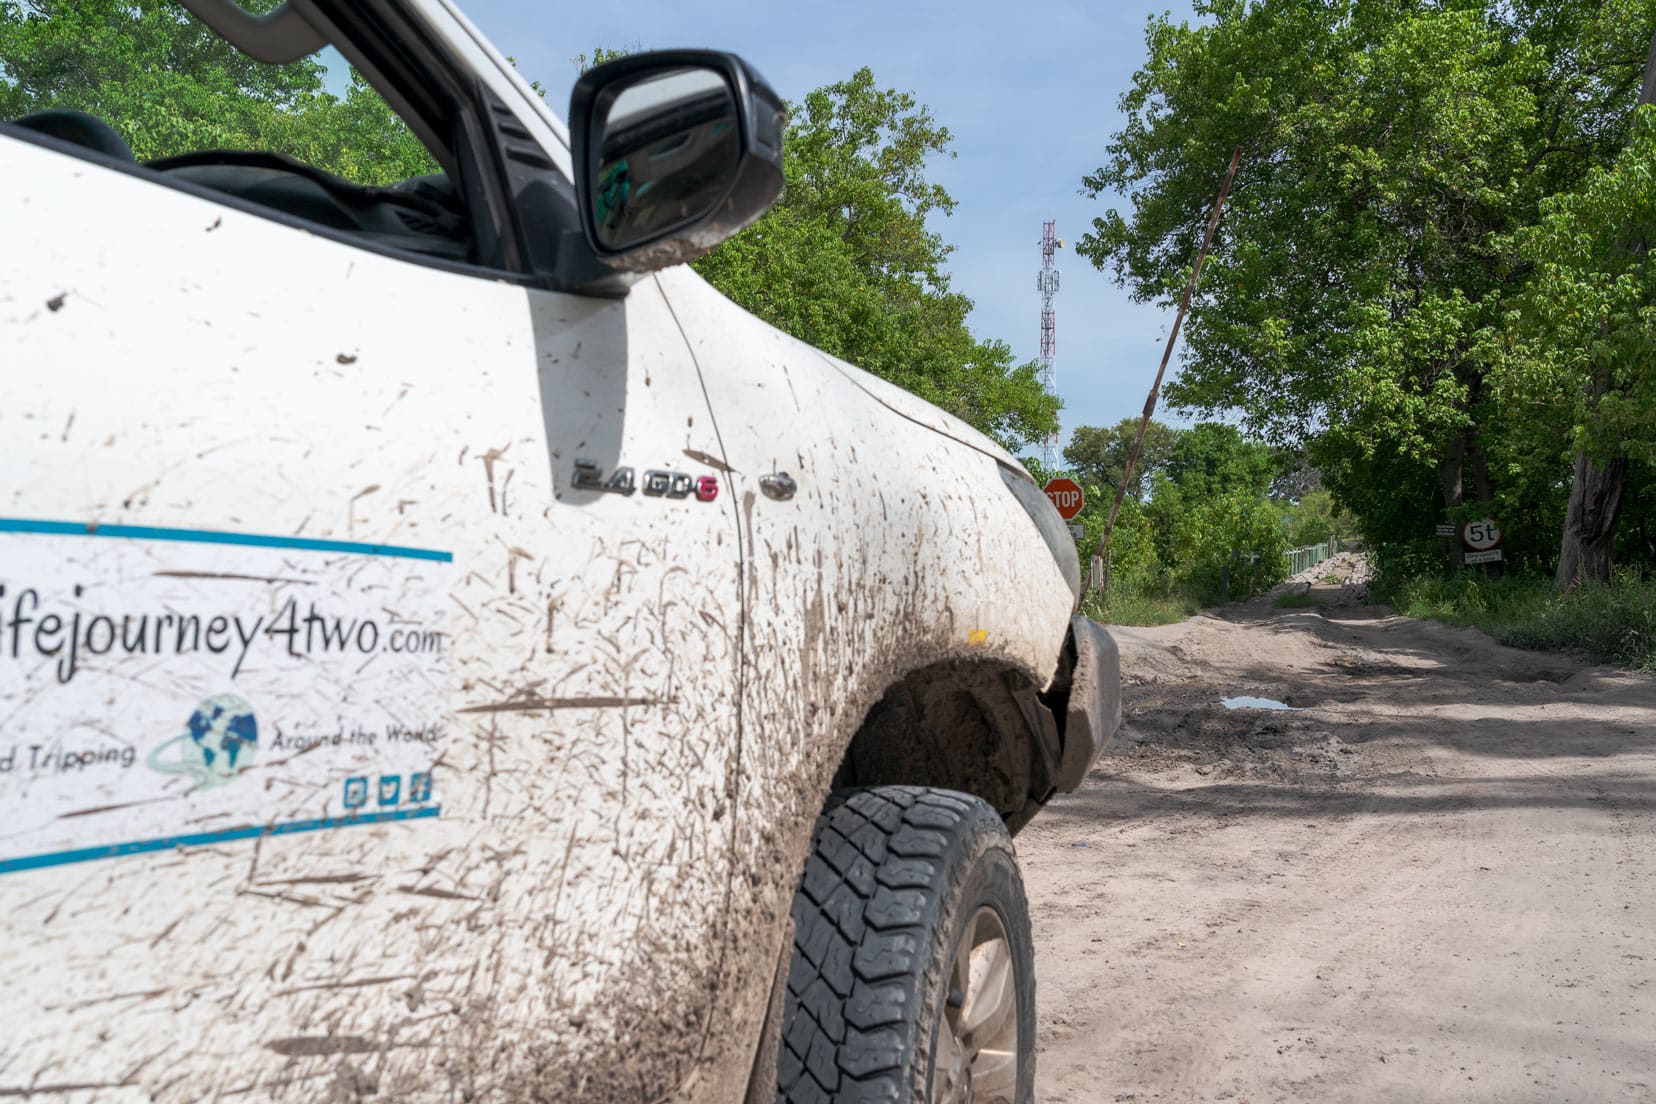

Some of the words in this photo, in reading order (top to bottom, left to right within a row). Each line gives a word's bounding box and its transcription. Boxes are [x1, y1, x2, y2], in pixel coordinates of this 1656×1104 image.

[1470, 524, 1497, 543] 5t
[269, 725, 344, 751] Around
[350, 724, 377, 746] the
[28, 743, 136, 773] Tripping
